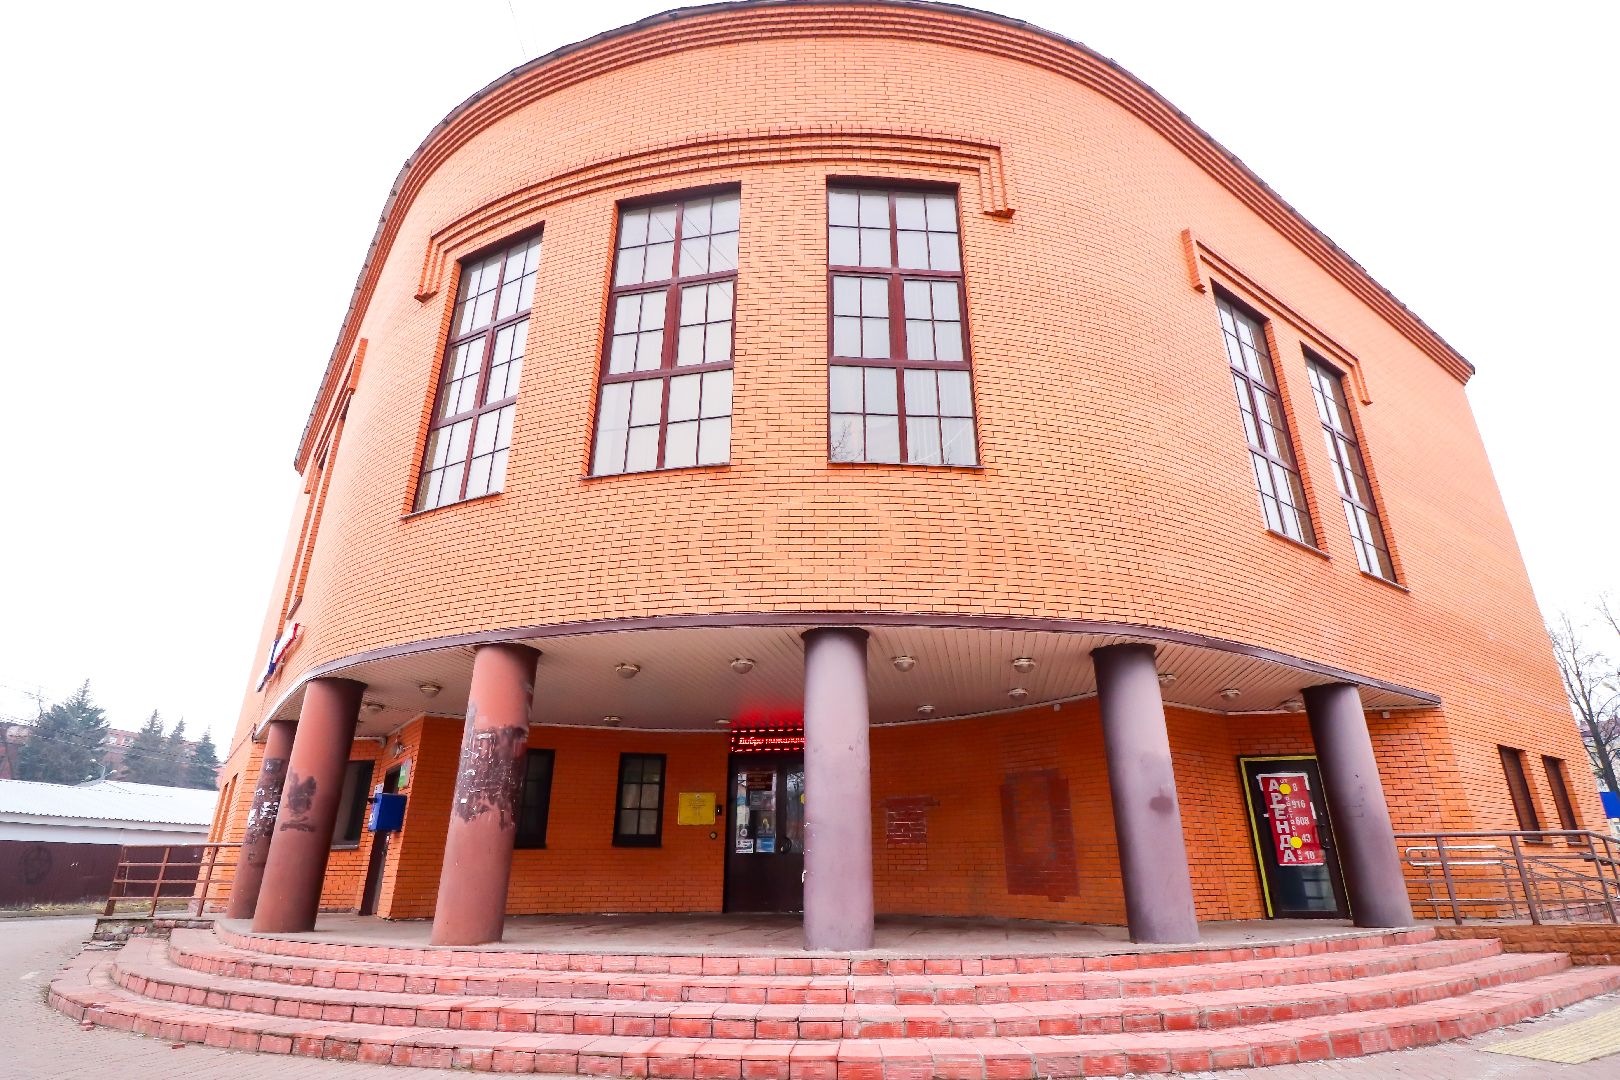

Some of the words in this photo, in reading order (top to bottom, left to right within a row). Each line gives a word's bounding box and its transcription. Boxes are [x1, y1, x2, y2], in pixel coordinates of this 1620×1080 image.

[1291, 800, 1306, 809] 916
[1269, 779, 1297, 862] АРЕНДА
[1295, 816, 1310, 826] 608
